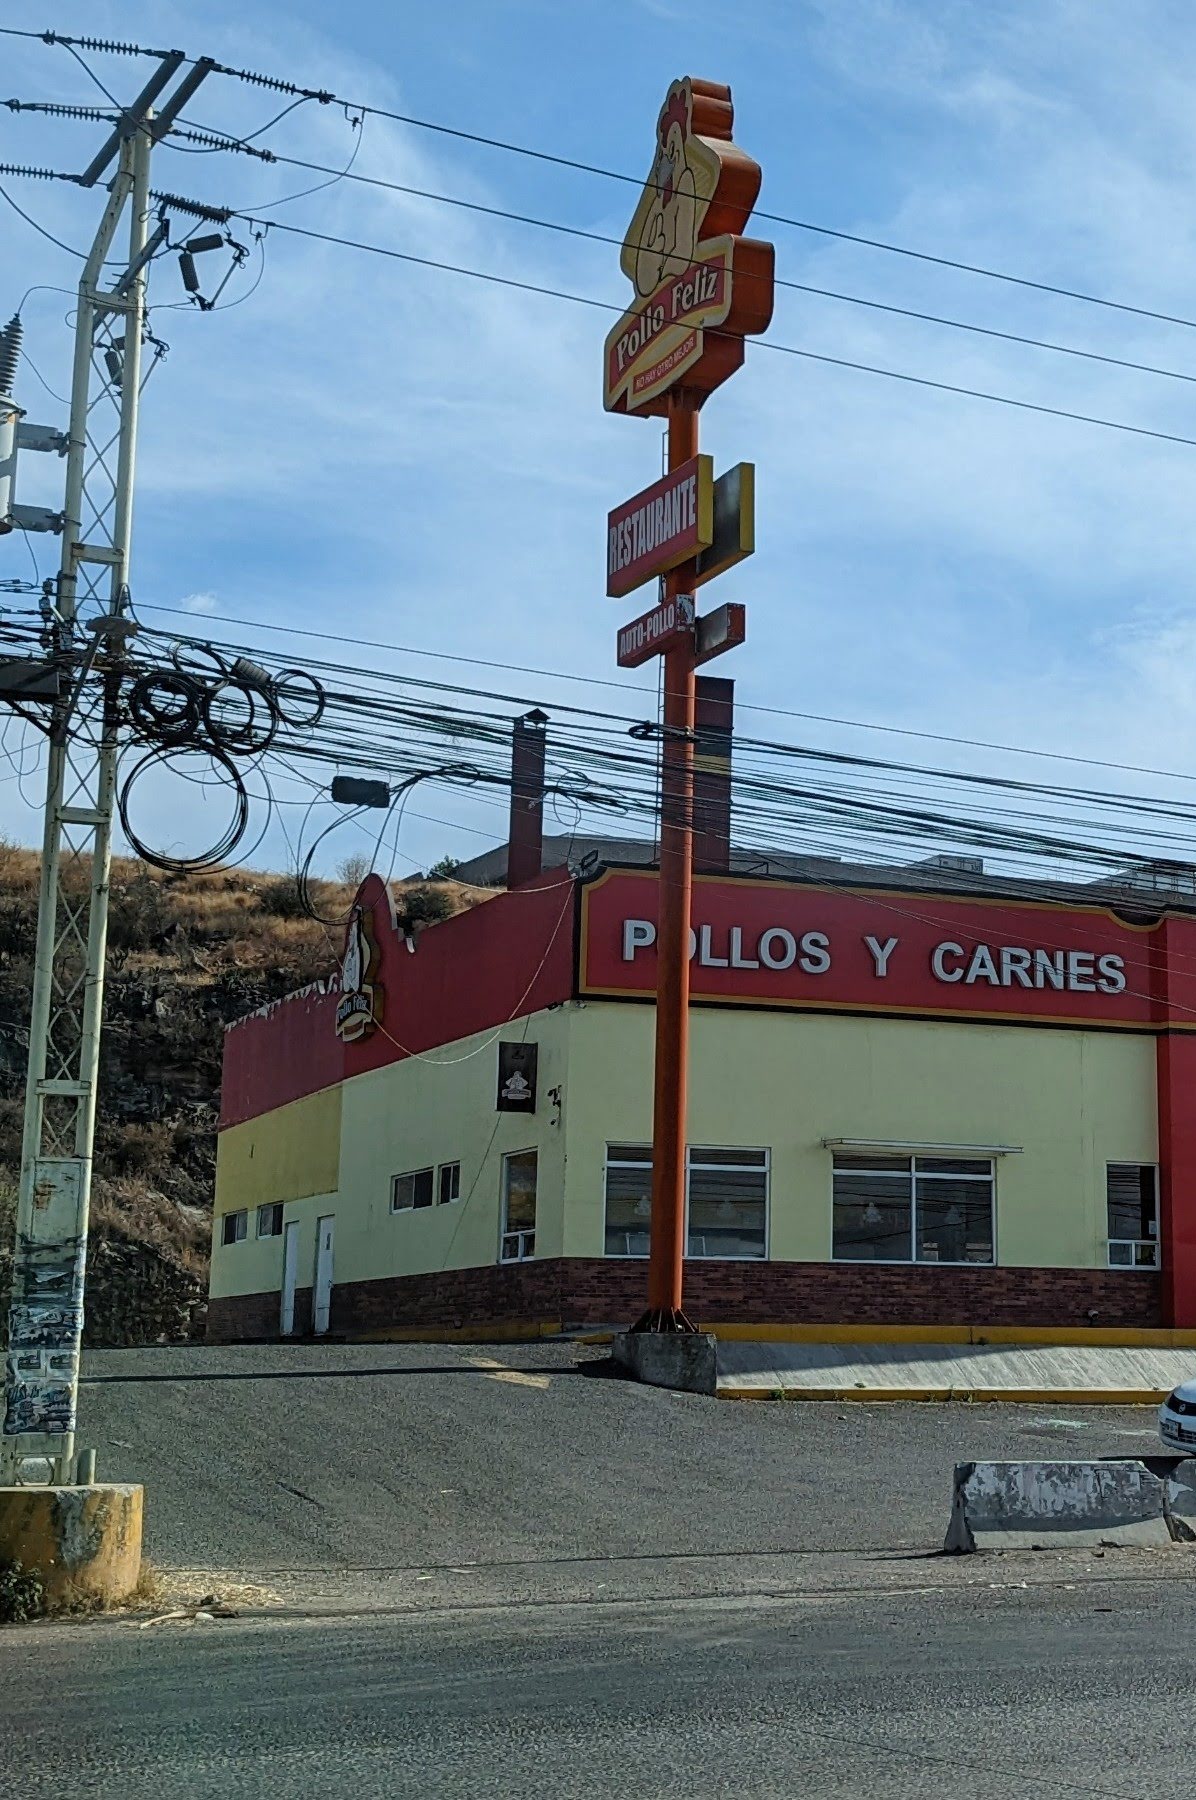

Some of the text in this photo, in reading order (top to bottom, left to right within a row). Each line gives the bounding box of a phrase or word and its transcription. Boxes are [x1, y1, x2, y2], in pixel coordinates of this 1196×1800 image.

[616, 266, 718, 371] Pollo Feliz
[609, 474, 696, 576] RESTAURANTE
[619, 603, 675, 656] AUTO-POLLO
[622, 919, 1128, 994] PLLOS Y CARNES
